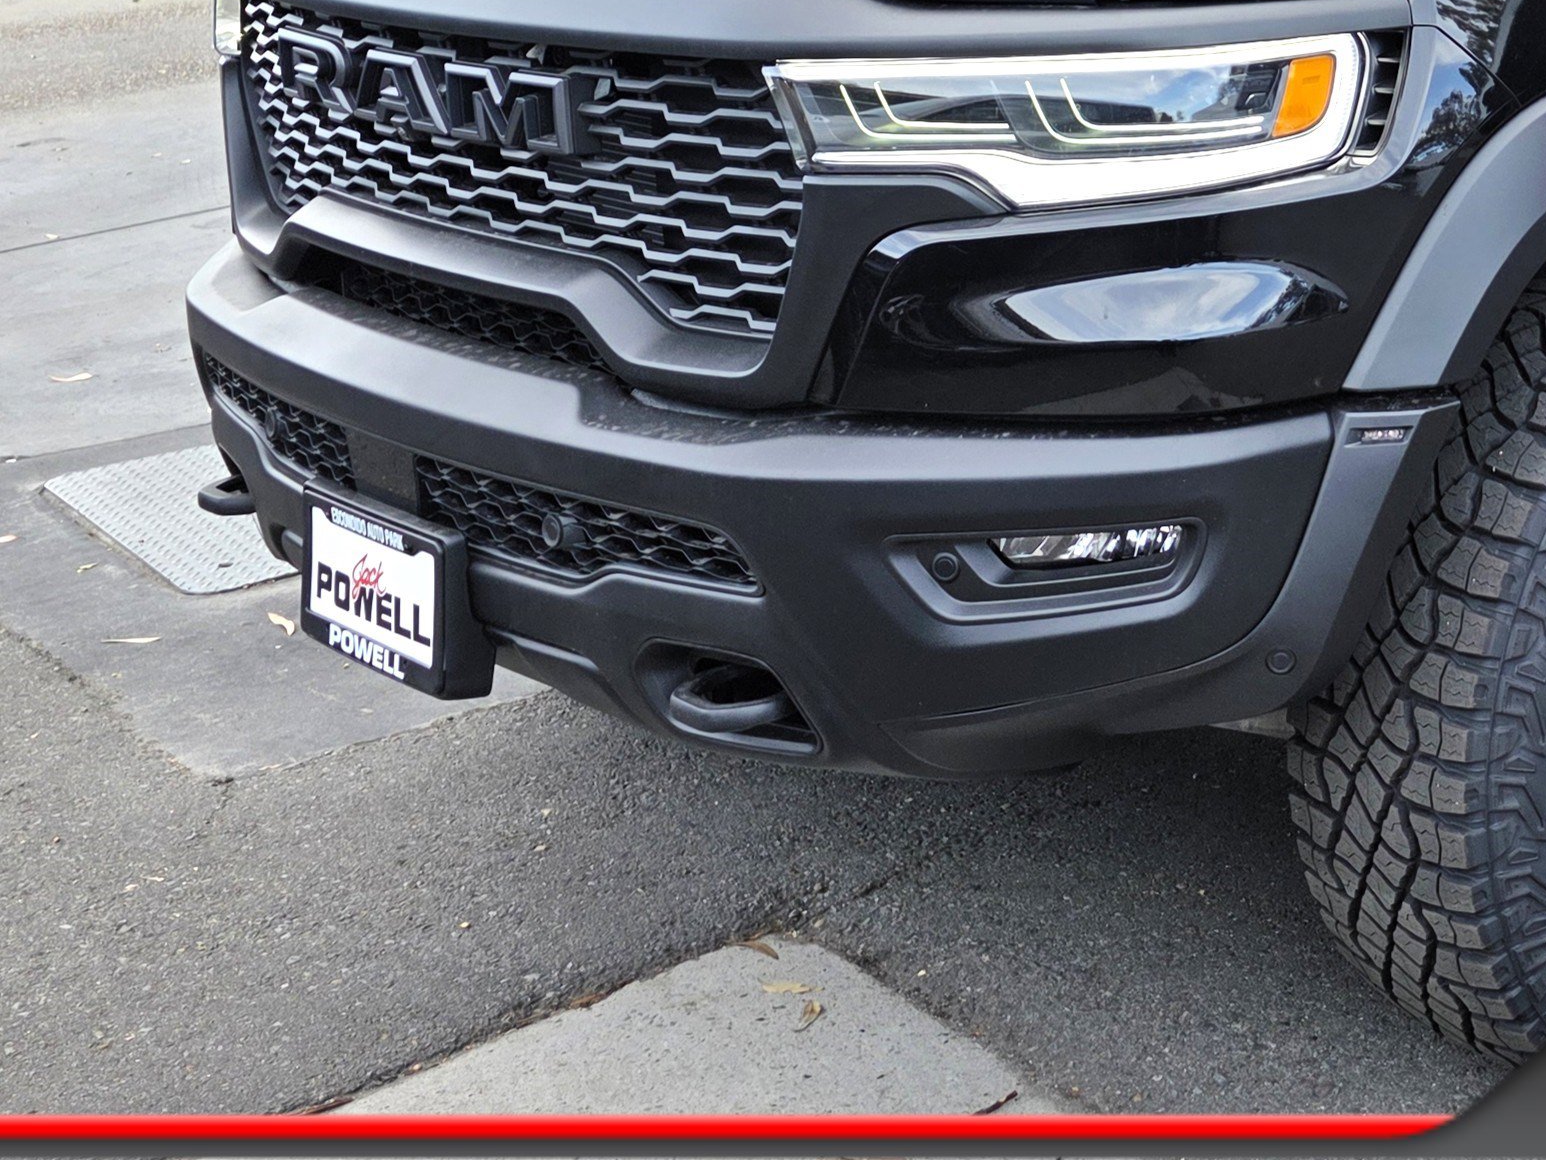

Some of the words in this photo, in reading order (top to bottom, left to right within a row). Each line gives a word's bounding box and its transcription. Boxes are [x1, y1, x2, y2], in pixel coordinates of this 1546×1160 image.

[277, 27, 577, 155] RAM
[317, 561, 431, 647] POWELL
[352, 553, 387, 600] Jack
[328, 622, 405, 680] POWELL
